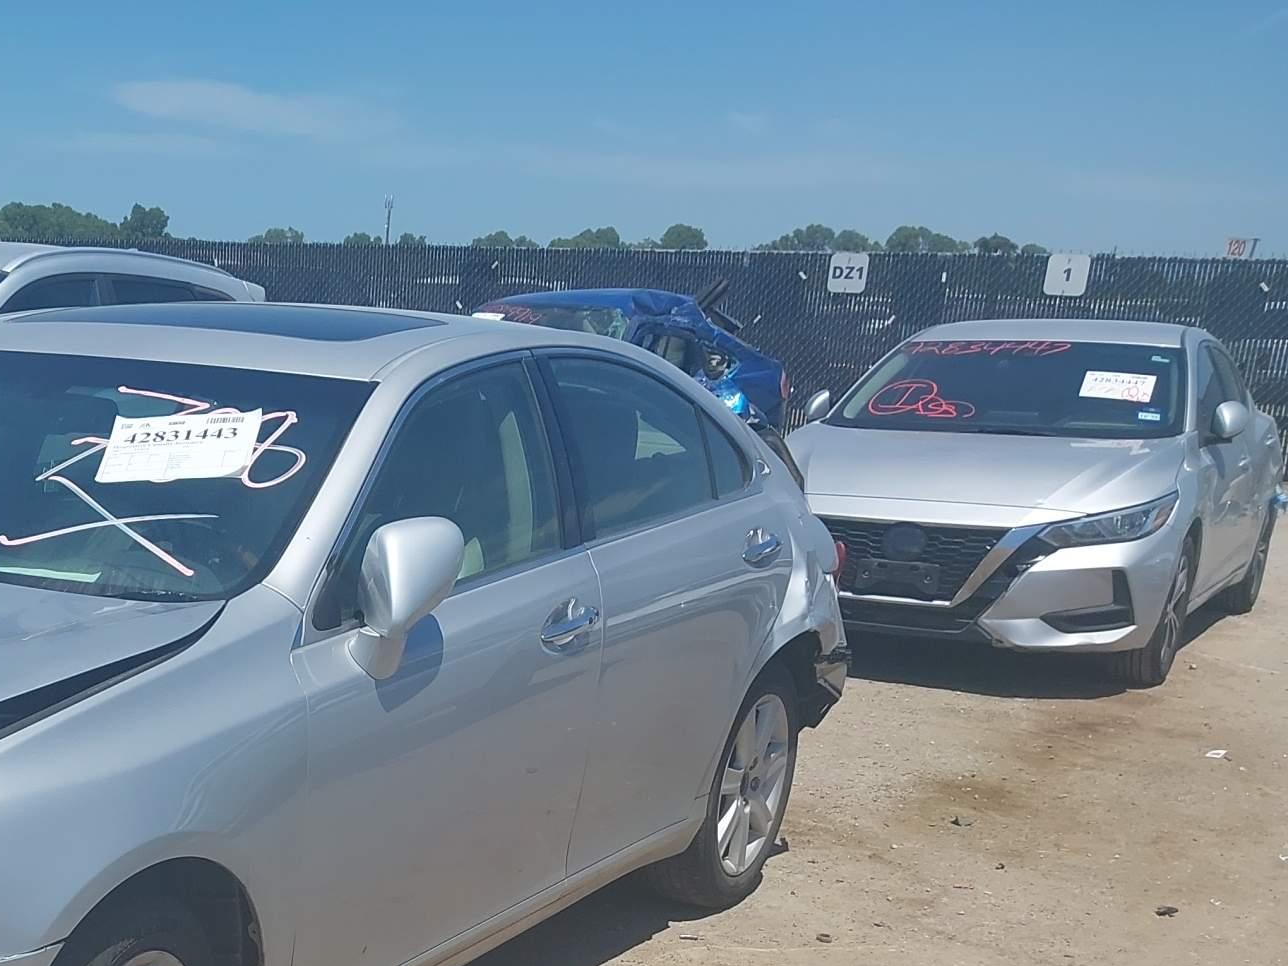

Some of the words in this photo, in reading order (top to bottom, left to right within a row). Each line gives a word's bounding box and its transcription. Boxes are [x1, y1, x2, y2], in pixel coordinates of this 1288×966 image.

[831, 266, 864, 280] DZ1
[1063, 267, 1073, 281] 1
[123, 426, 239, 444] 42831443
